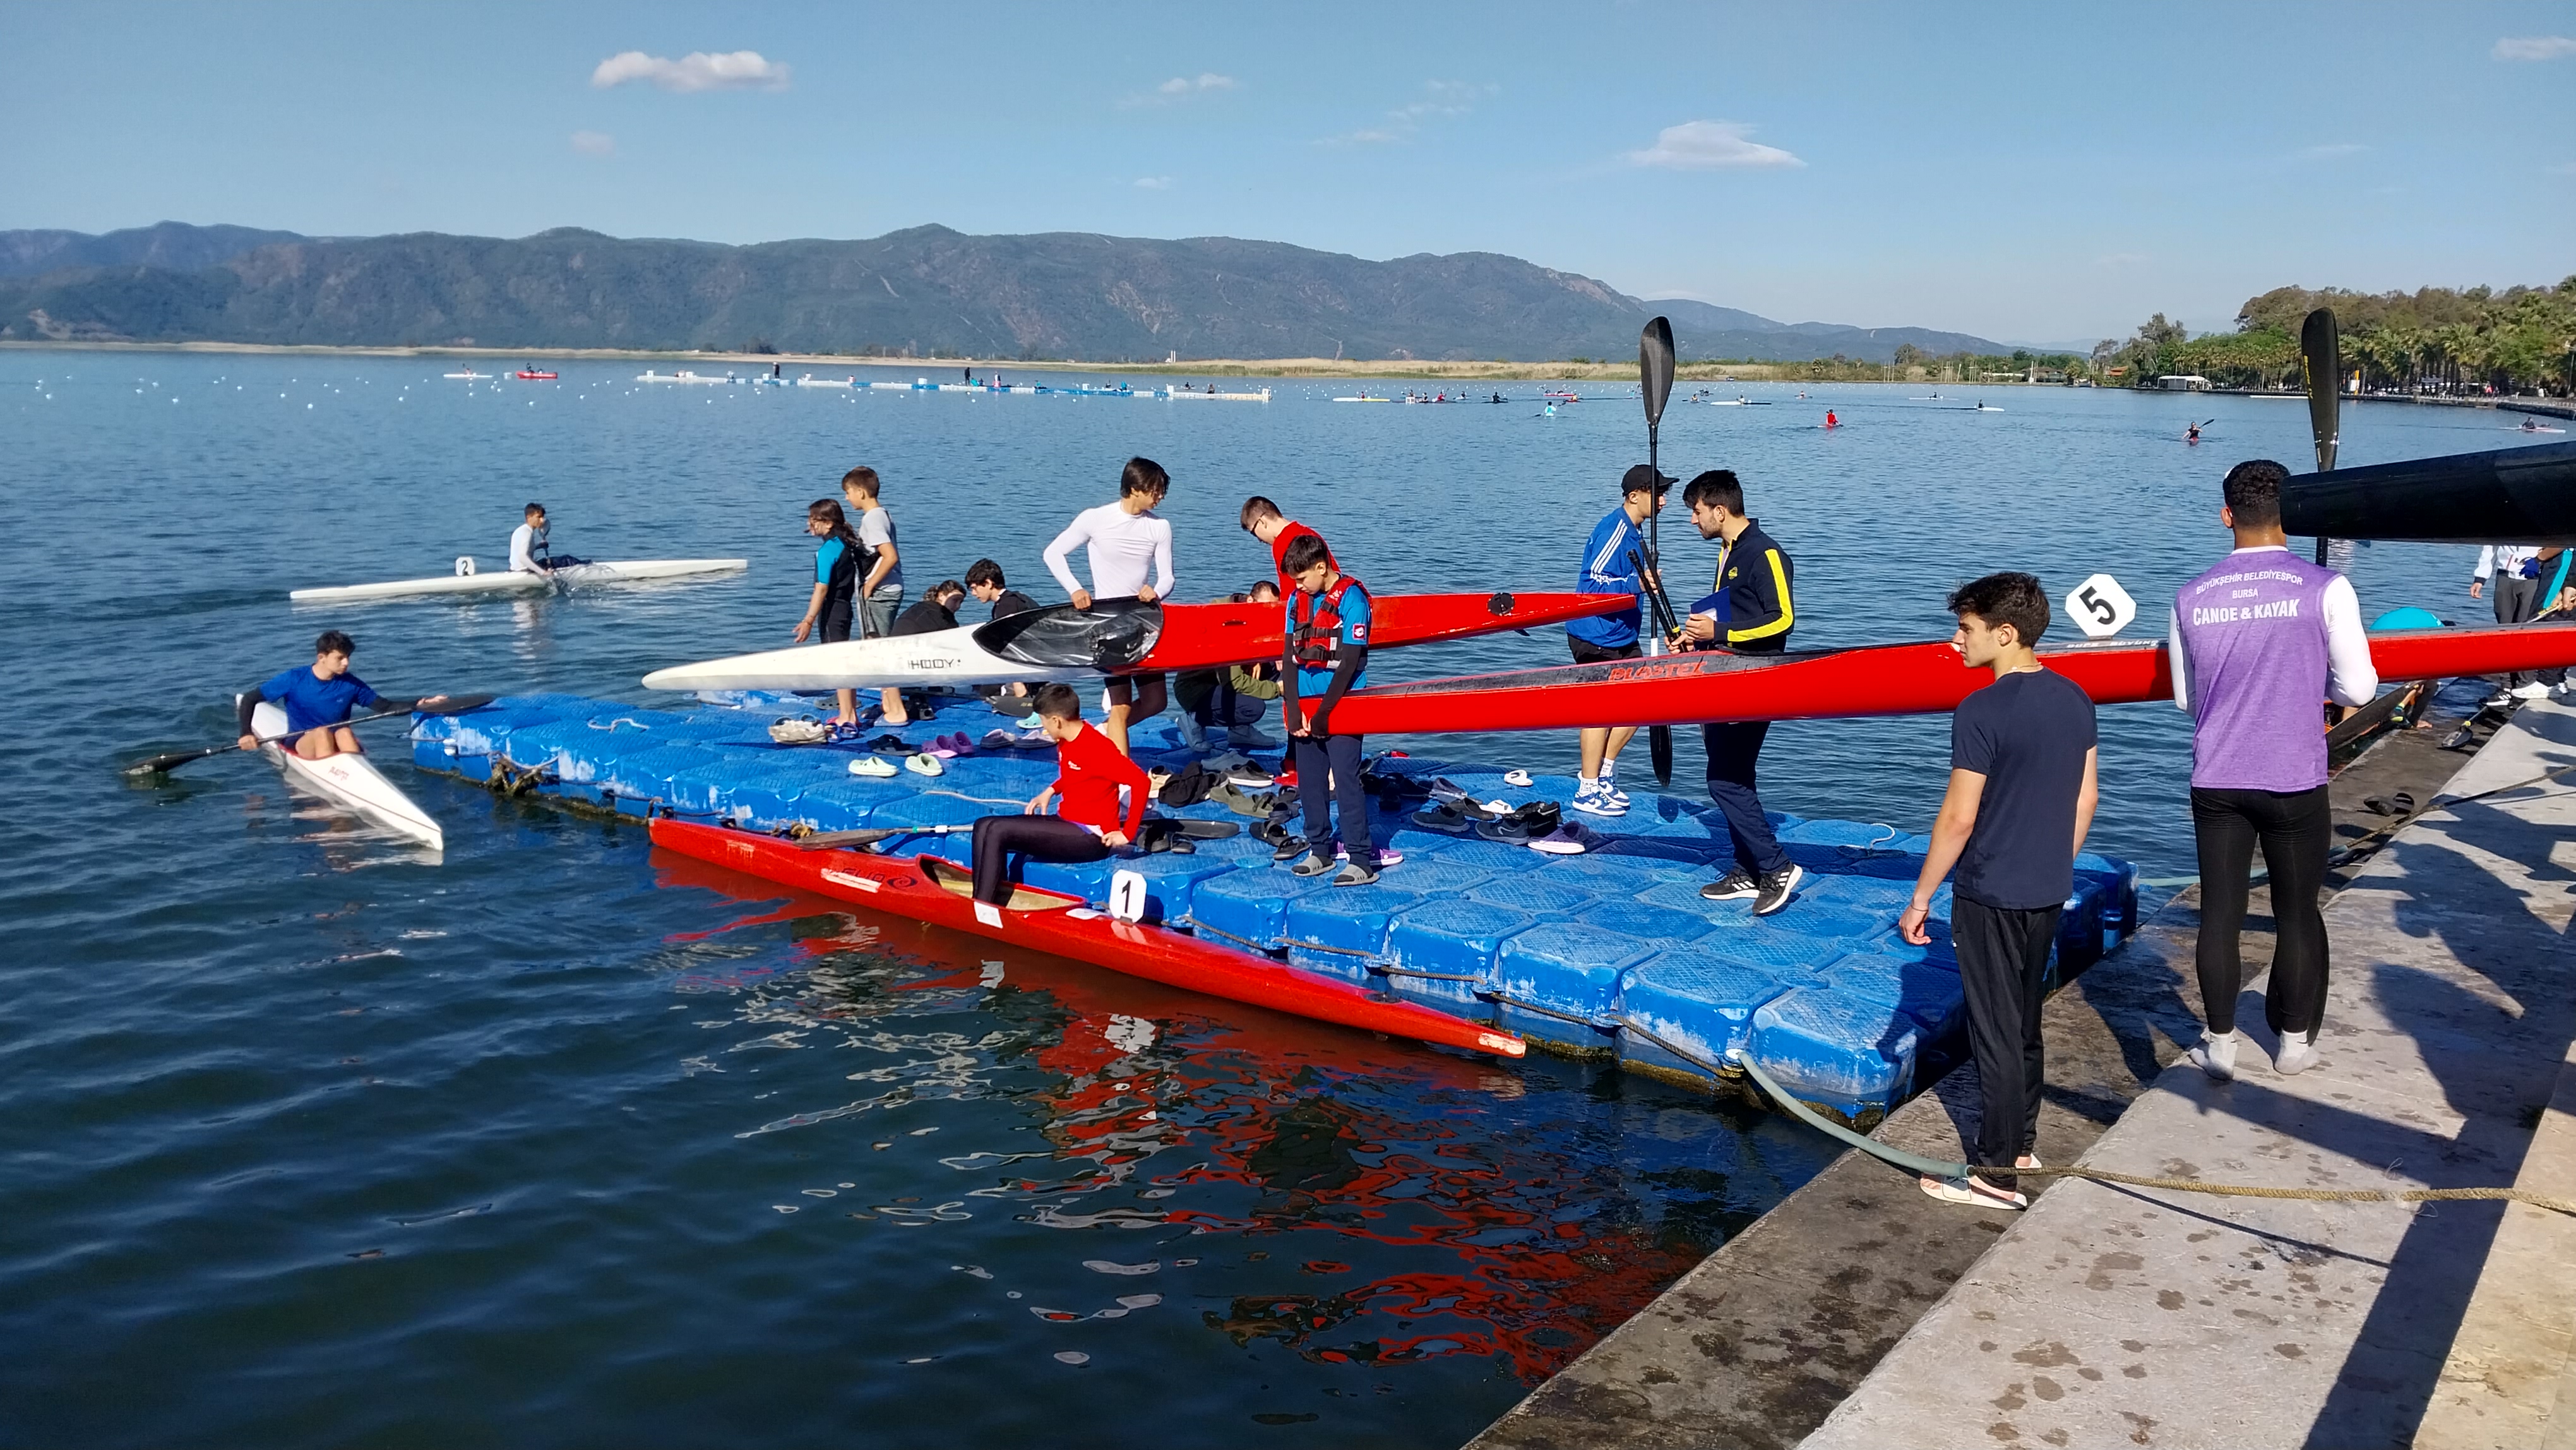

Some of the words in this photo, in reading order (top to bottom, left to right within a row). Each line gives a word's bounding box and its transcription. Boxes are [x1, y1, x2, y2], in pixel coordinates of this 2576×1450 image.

[462, 560, 468, 575] 2
[2196, 572, 2242, 596] BÜYÜKŞEHİR
[2244, 569, 2303, 585] BELEDİYESPOR
[2232, 588, 2258, 599] BURSA
[2078, 585, 2116, 625] 5
[2193, 607, 2238, 626] CANOE
[2241, 607, 2252, 620] &
[2254, 599, 2301, 619] KAYAK
[1121, 880, 1131, 914] 1
